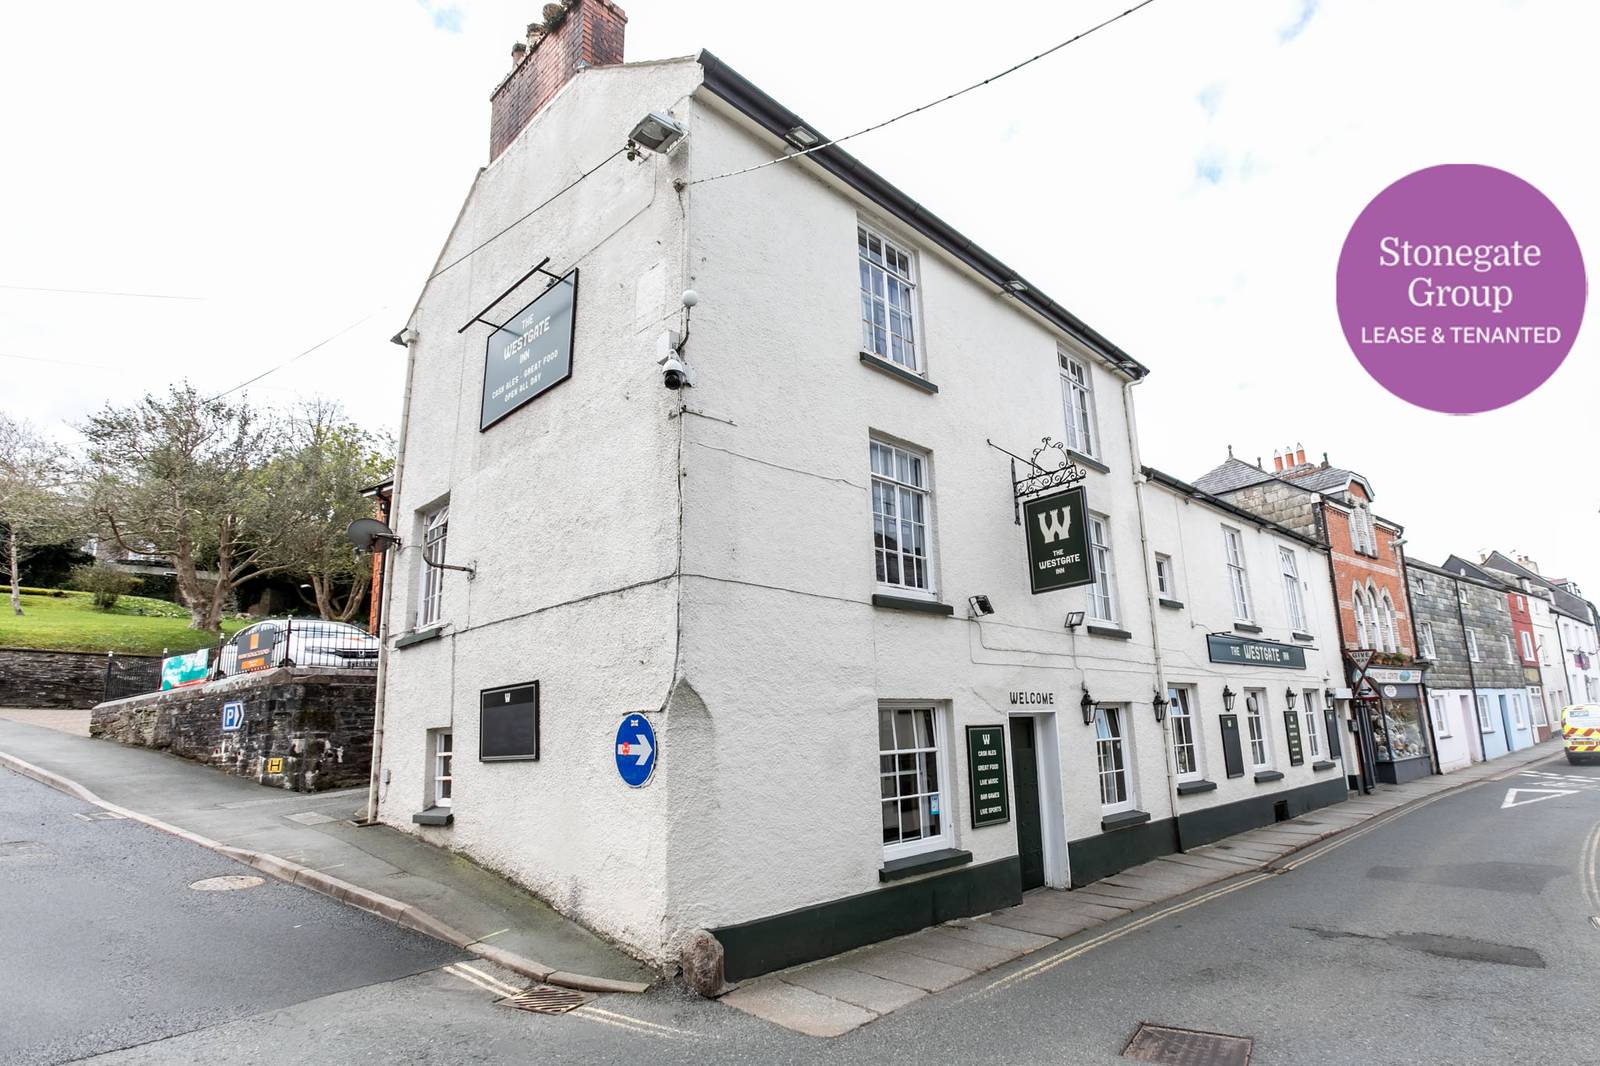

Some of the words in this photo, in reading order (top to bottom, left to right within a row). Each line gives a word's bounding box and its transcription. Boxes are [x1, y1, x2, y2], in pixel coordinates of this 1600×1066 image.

[522, 313, 534, 328] THE
[504, 316, 551, 360] WESTGATE
[520, 348, 530, 364] INN
[492, 385, 504, 399] CASK
[506, 376, 519, 390] ALES
[524, 360, 542, 378] GREAT
[543, 349, 559, 365] FOOD
[504, 388, 518, 402] OPEN
[519, 380, 528, 392] ALL
[530, 372, 542, 386] DAY
[1038, 506, 1071, 544] W
[1053, 548, 1064, 556] THE
[1038, 554, 1080, 570] WESTGATE
[1230, 646, 1240, 656] THE
[1243, 644, 1280, 661] WESTGATE
[1010, 692, 1054, 704] WELCOME
[226, 710, 234, 726] P
[982, 734, 990, 745] W
[270, 760, 280, 771] H
